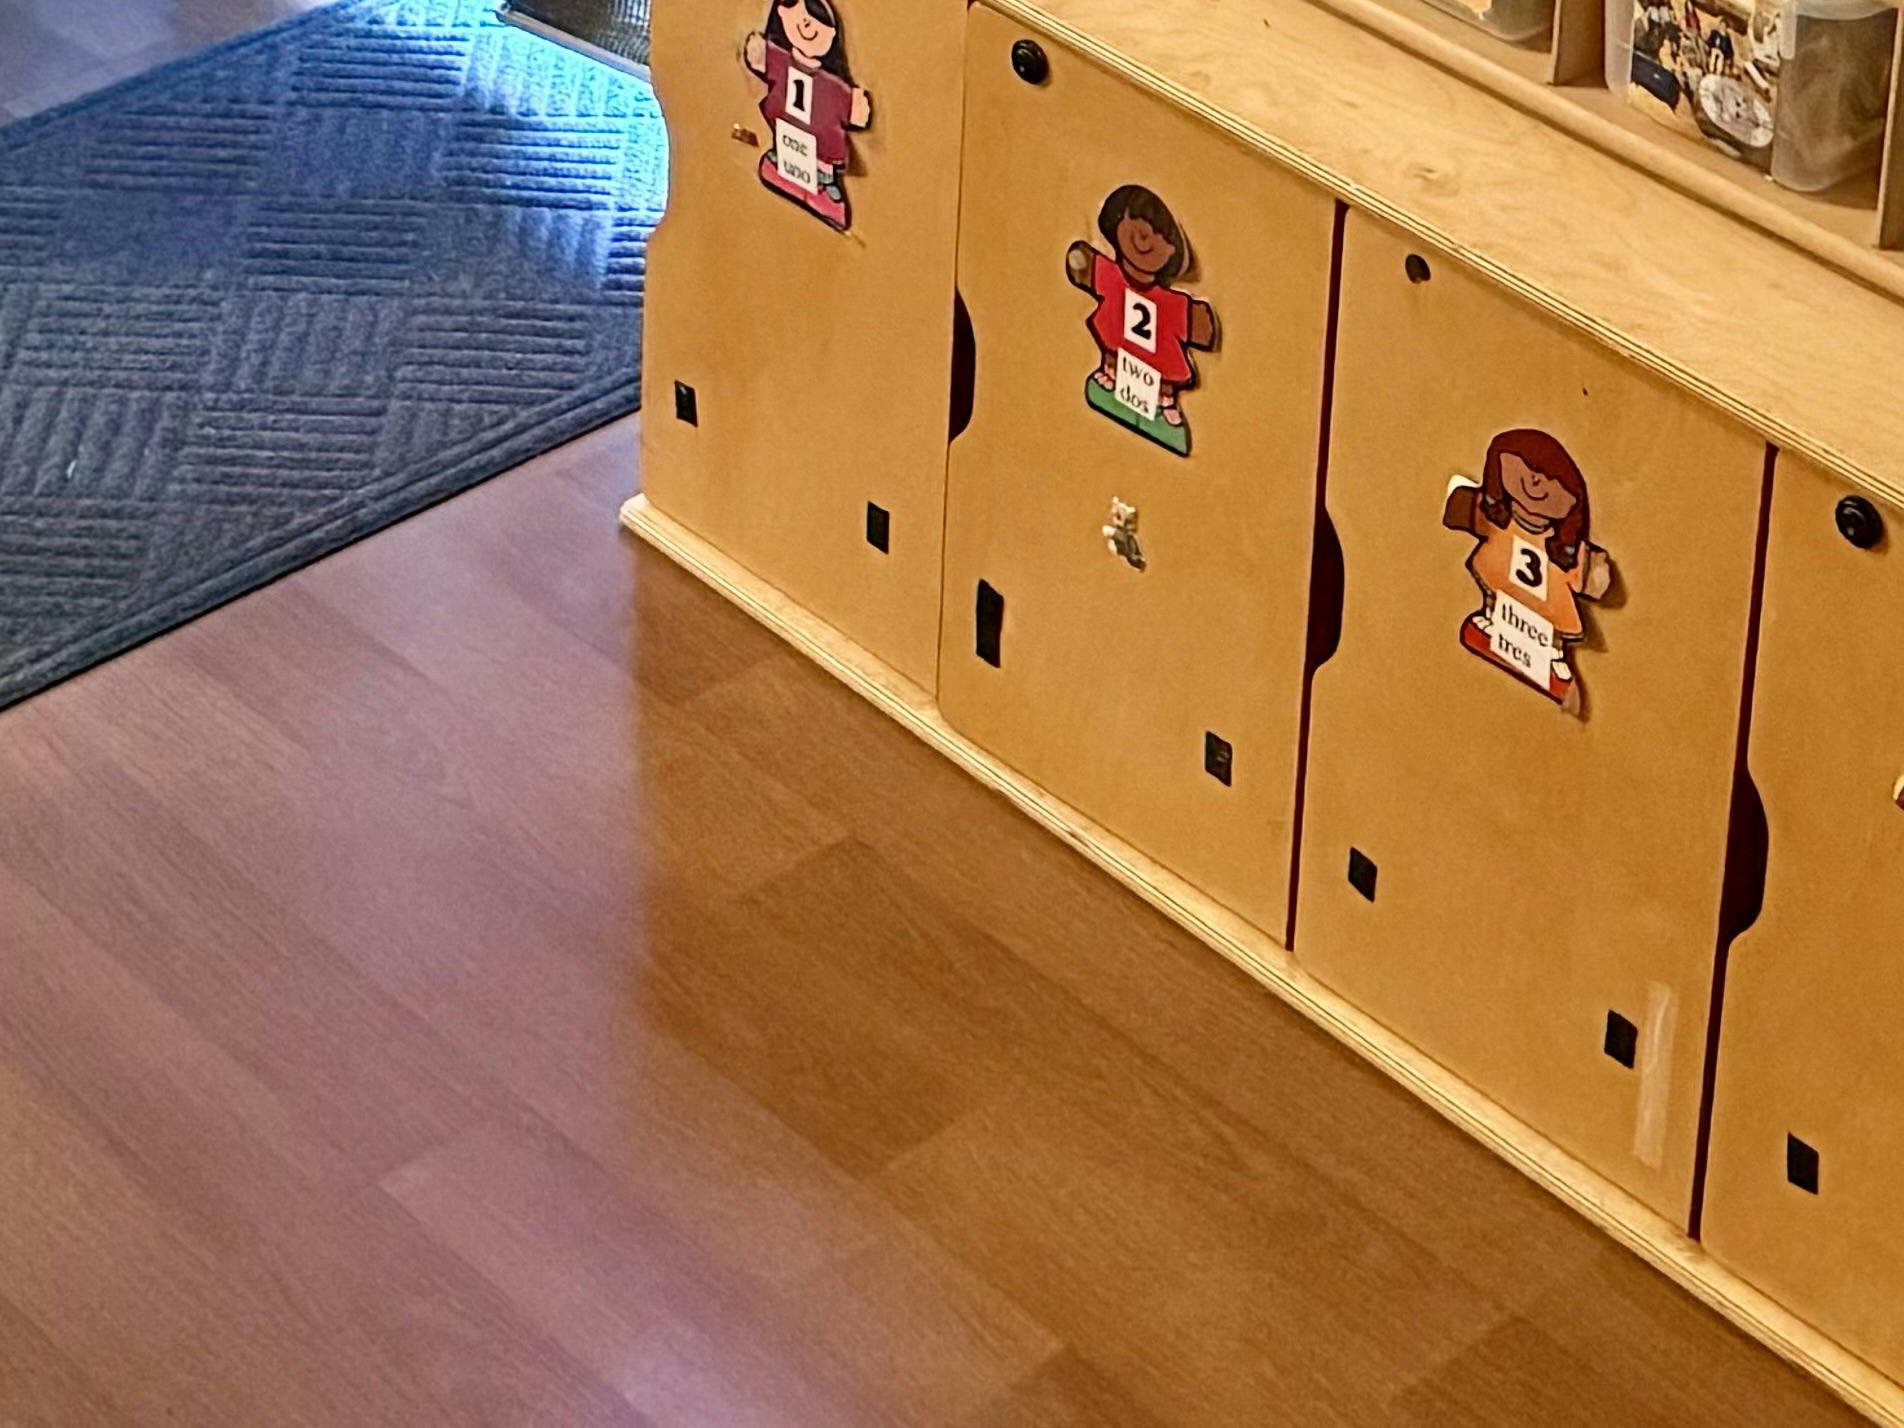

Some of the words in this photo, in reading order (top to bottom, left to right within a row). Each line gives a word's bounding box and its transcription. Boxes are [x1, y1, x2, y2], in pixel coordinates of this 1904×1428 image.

[792, 78, 807, 112] 1
[782, 134, 809, 158] one
[783, 160, 811, 185] uno
[1131, 301, 1153, 341] 2
[1122, 356, 1154, 387] two
[1119, 386, 1150, 415] dos
[1515, 547, 1544, 588] 3
[1500, 603, 1550, 648] three
[1498, 632, 1533, 669] tres
